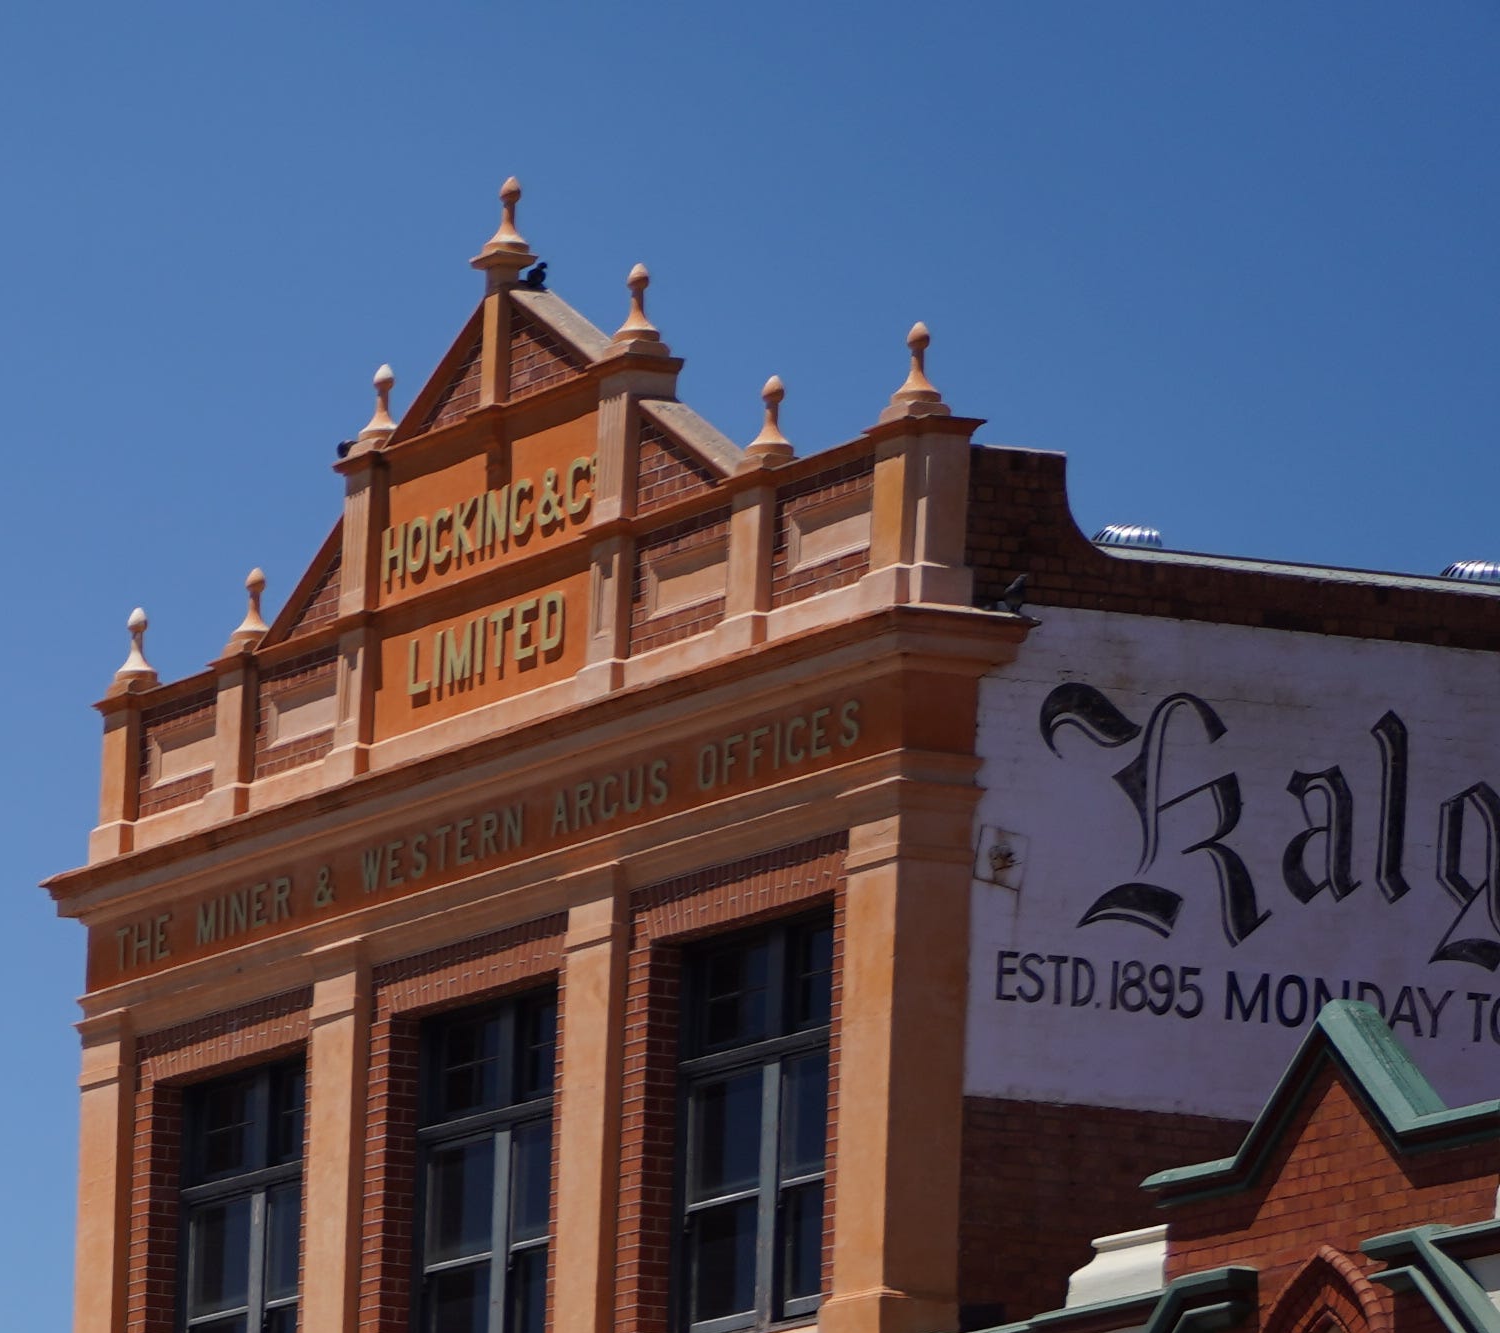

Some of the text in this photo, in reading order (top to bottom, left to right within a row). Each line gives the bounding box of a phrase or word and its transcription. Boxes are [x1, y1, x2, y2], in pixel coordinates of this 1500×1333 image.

[408, 591, 564, 696] LIMITED
[115, 912, 173, 973] THE
[197, 877, 292, 944] MINER
[313, 863, 335, 908] &
[361, 803, 524, 894] WESTERN
[696, 700, 861, 791] OFFICES
